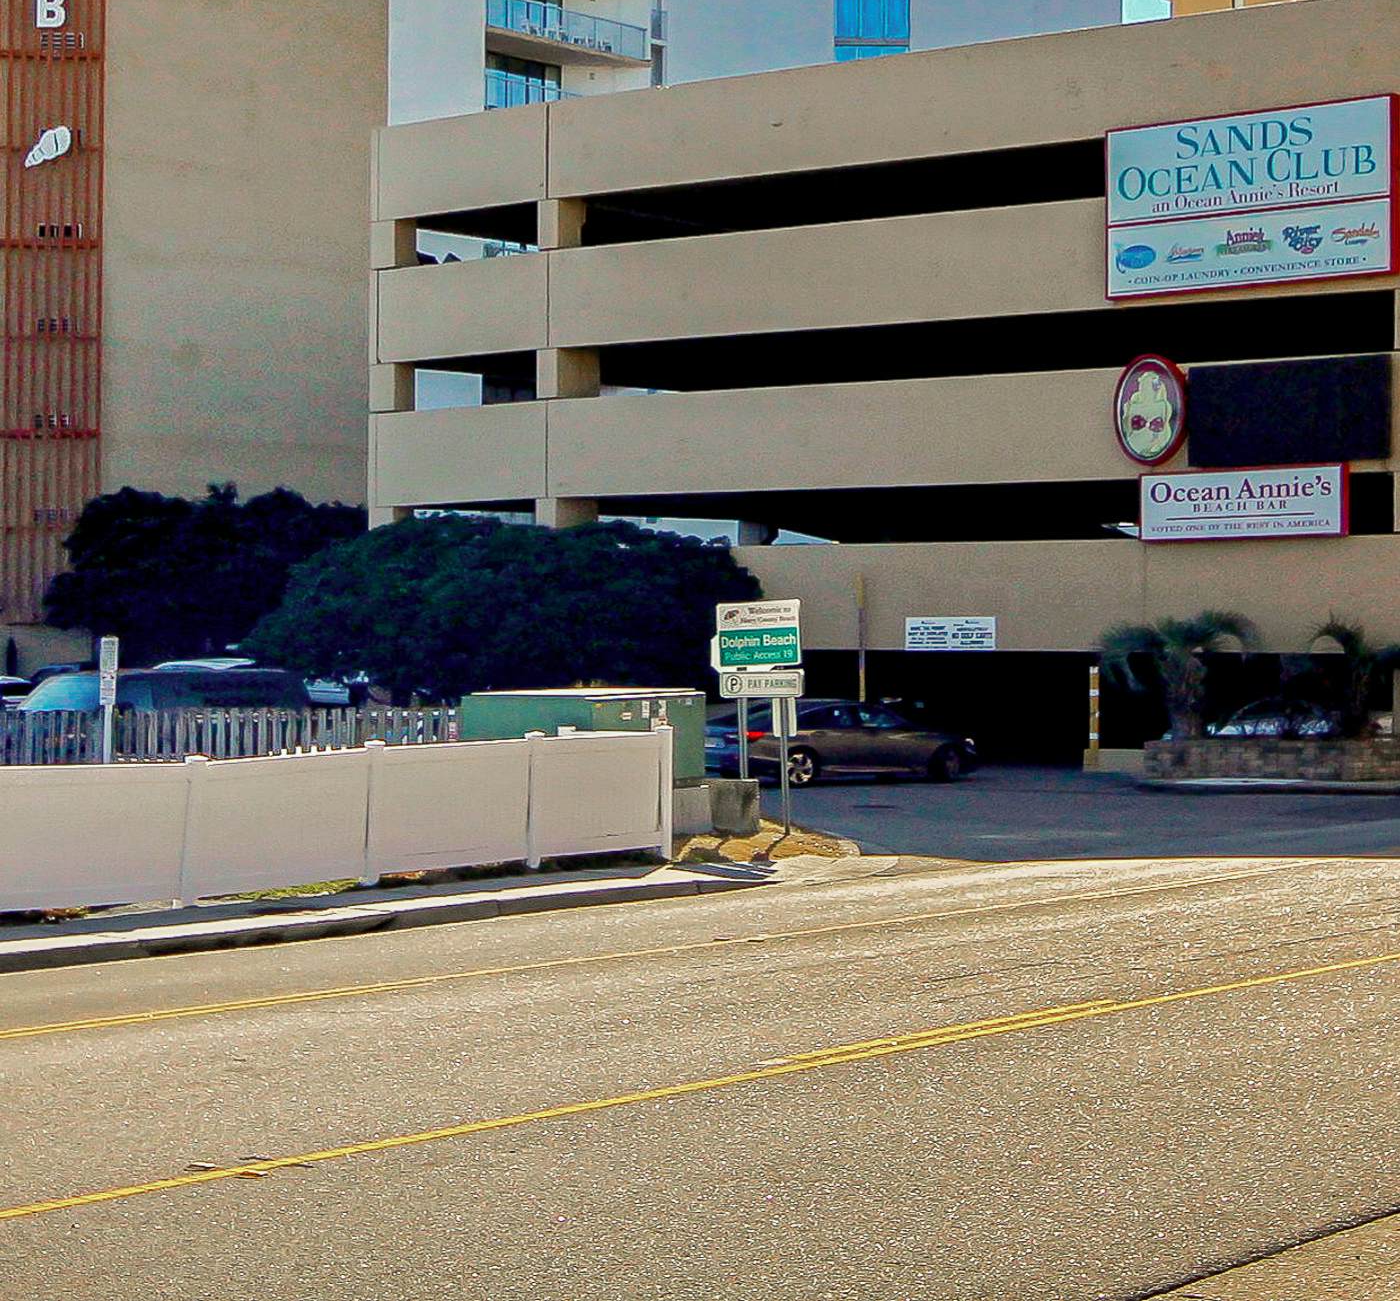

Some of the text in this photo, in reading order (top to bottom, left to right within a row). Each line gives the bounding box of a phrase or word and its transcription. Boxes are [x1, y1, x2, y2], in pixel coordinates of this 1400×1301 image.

[1176, 116, 1313, 160] SANDS
[1117, 144, 1377, 201] OCEAN CLUB
[1151, 180, 1340, 213] an Ocean Annie's Resort
[1133, 256, 1360, 285] COIN-OP LAUNDRY CONVENIENCE STORE
[1149, 475, 1332, 504] Ocean Annie's
[1193, 500, 1289, 513] BEACH BAR
[1224, 522, 1243, 530] THE
[1286, 519, 1331, 528] AMERICA
[720, 633, 796, 649] Dolphin Beach
[724, 652, 753, 661] Public
[753, 651, 781, 660] Access
[764, 678, 797, 688] PARKING
